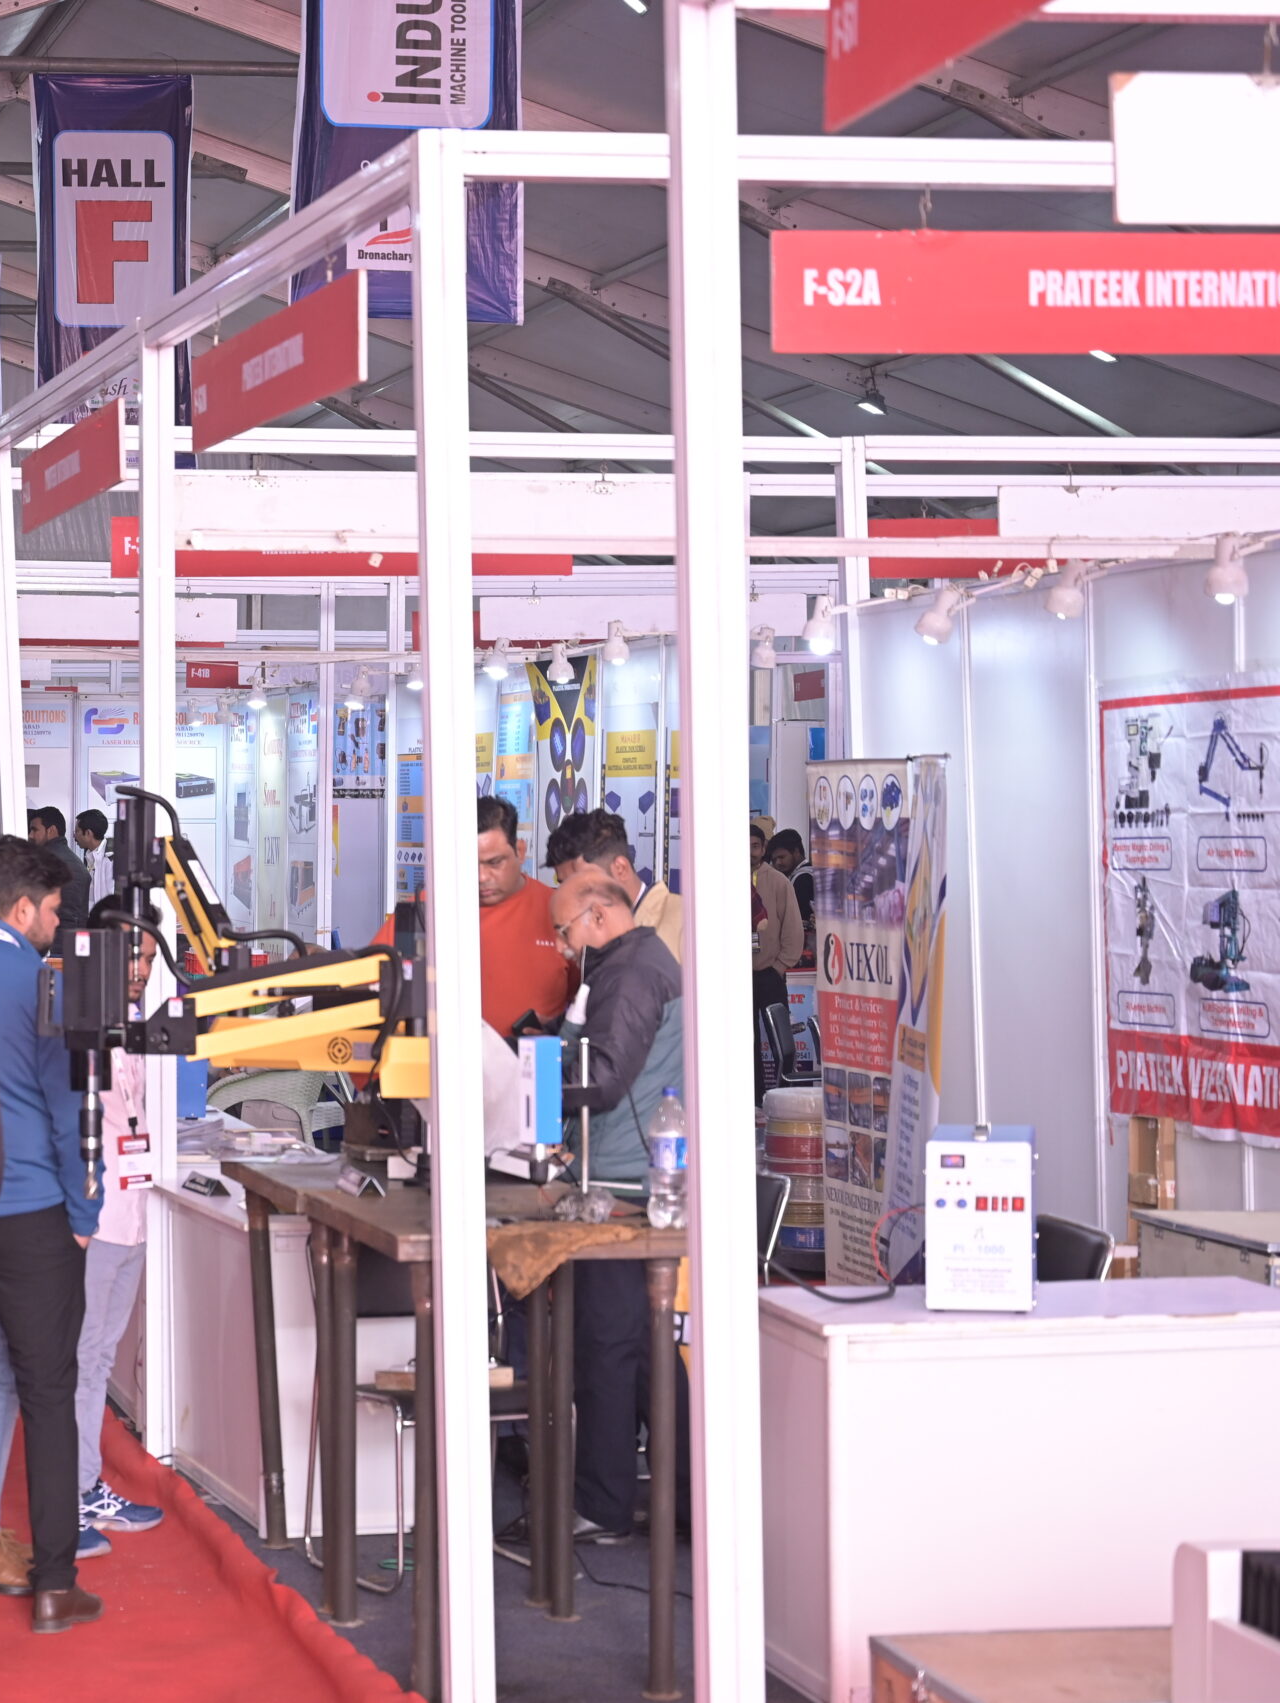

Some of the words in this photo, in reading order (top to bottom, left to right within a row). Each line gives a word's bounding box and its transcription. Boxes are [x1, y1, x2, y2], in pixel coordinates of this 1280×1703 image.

[450, 0, 466, 33] TOO
[450, 38, 466, 104] MACHINE
[61, 158, 166, 188] HALL
[75, 199, 152, 304] F
[803, 267, 882, 307] F-S2A
[1028, 269, 1140, 307] PRATEEK
[191, 668, 210, 678] F-41B
